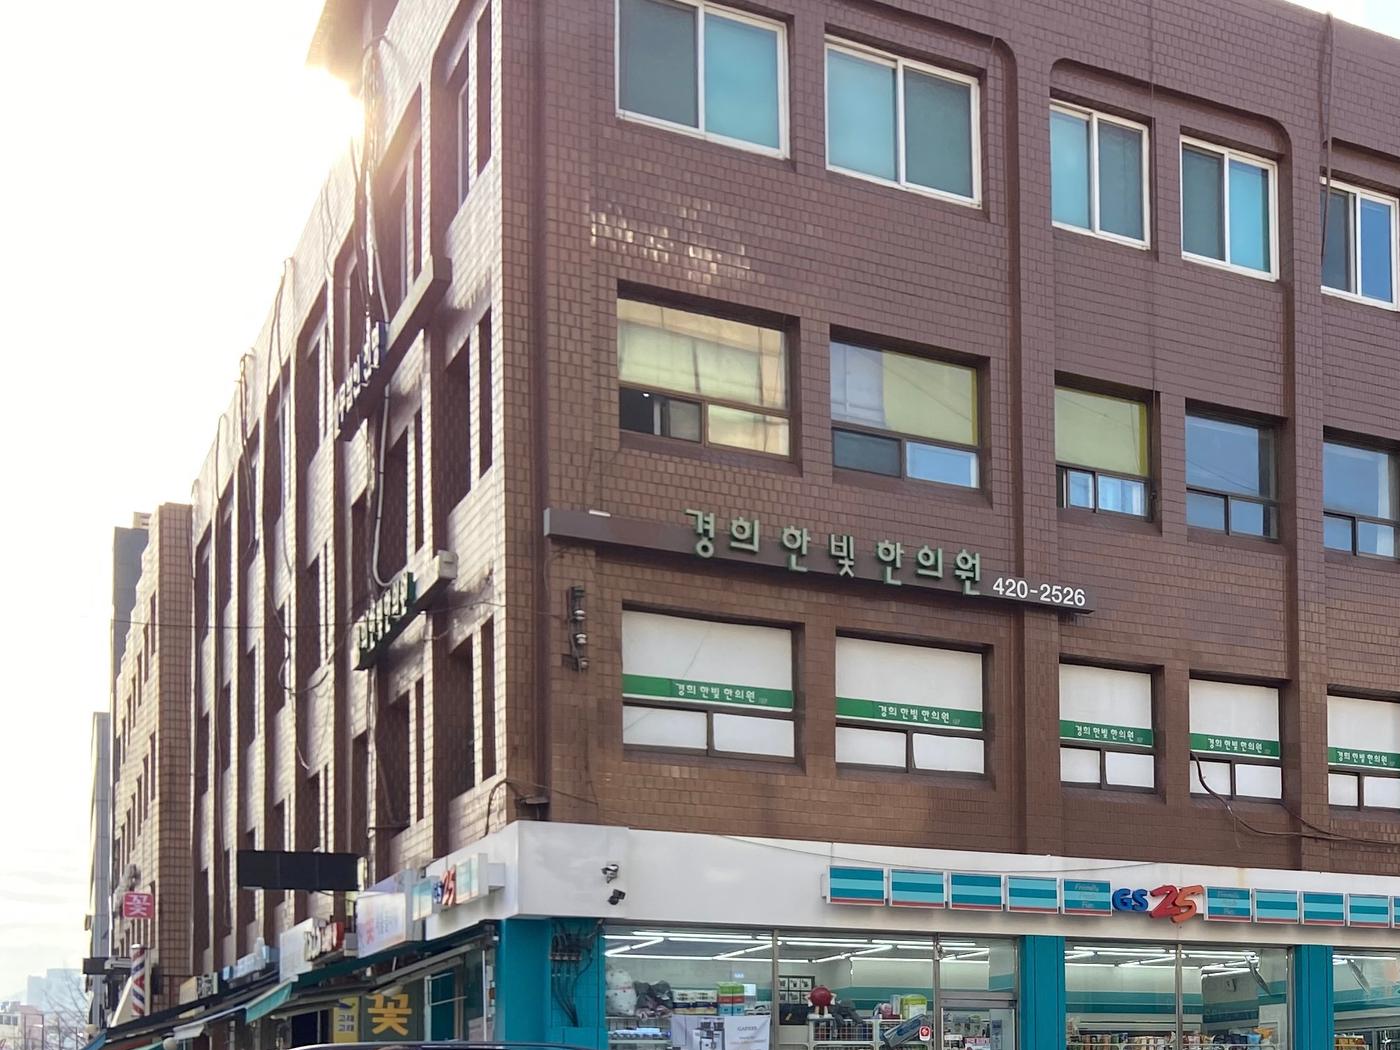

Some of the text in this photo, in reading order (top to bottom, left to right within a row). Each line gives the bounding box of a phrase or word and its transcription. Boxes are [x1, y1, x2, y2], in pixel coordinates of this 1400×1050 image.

[684, 508, 981, 596] 경희 한빛 한의원
[992, 576, 1087, 607] 420-2526
[675, 682, 697, 697] 경희
[723, 688, 755, 703] 한의원
[878, 704, 897, 718] 경희
[921, 709, 949, 724] 한의원
[1112, 884, 1204, 923] GS25
[366, 993, 413, 1036] 꽃
